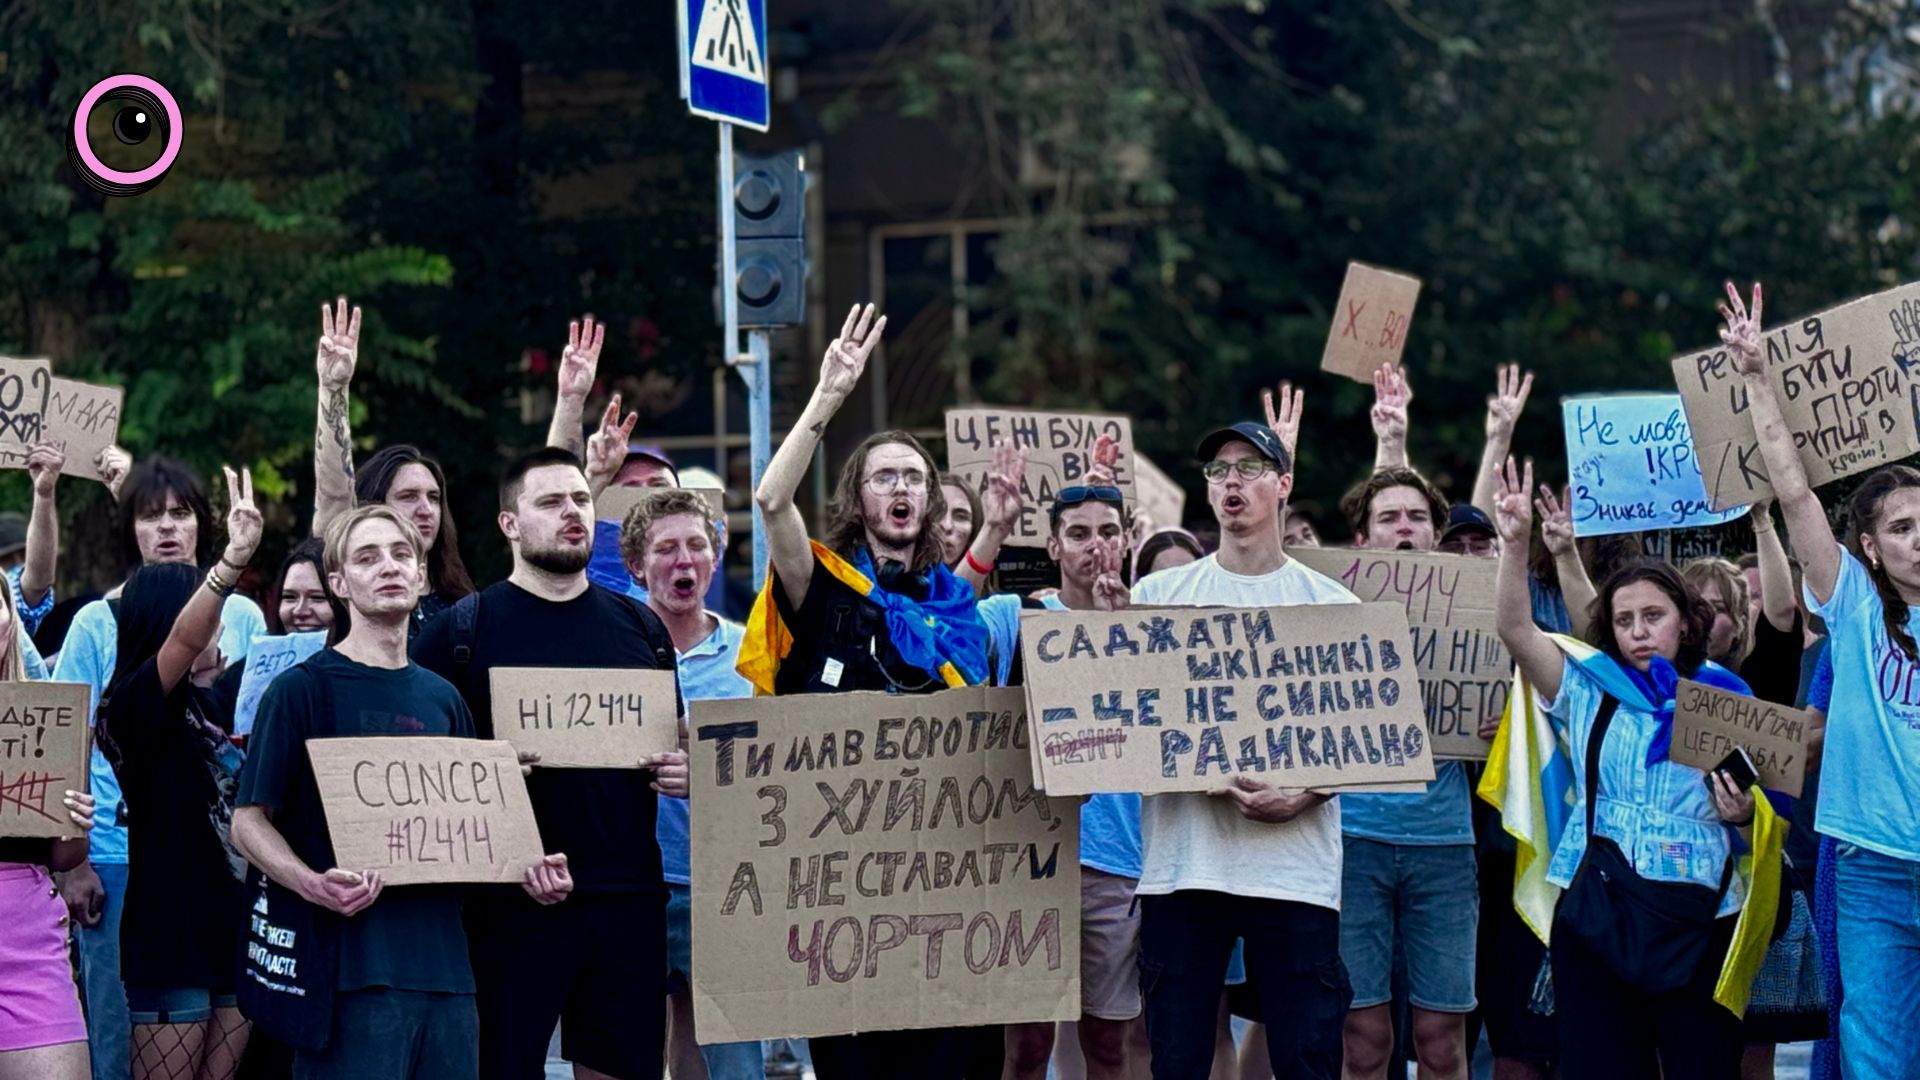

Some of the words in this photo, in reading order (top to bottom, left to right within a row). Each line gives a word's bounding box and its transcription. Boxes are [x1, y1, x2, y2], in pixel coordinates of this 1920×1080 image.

[0, 367, 51, 430] О?
[1782, 345, 1852, 401] БУТИ
[1812, 366, 1902, 431] ПРОТИ
[1577, 405, 1619, 446] Не
[1629, 408, 1691, 446] мовч
[1062, 452, 1131, 485] ВЕ
[1576, 485, 1656, 522] Зникає
[1036, 609, 1276, 664] САДЖАТИ
[1186, 633, 1402, 681] ШКІДНИКІВ
[565, 692, 644, 730] 12414
[1092, 688, 1163, 728] ЦЕ
[1185, 685, 1238, 724] НЕ
[1256, 676, 1401, 722] СИЛЬНО
[1682, 687, 1749, 728] ЗАКОН
[0, 726, 46, 759] ТІ!
[784, 729, 864, 773] МАВ
[874, 709, 1029, 762] БОРОТИС
[1160, 722, 1425, 779] РАДИКАЛЬНО
[755, 783, 788, 848] З
[809, 766, 1062, 838] ХУЙЛОМ,
[385, 815, 496, 865] #12414
[720, 861, 763, 916] А
[786, 851, 849, 910] НЕ
[855, 841, 1061, 897] СТАВАТИ
[787, 907, 1062, 987] ЧОРТОМ
